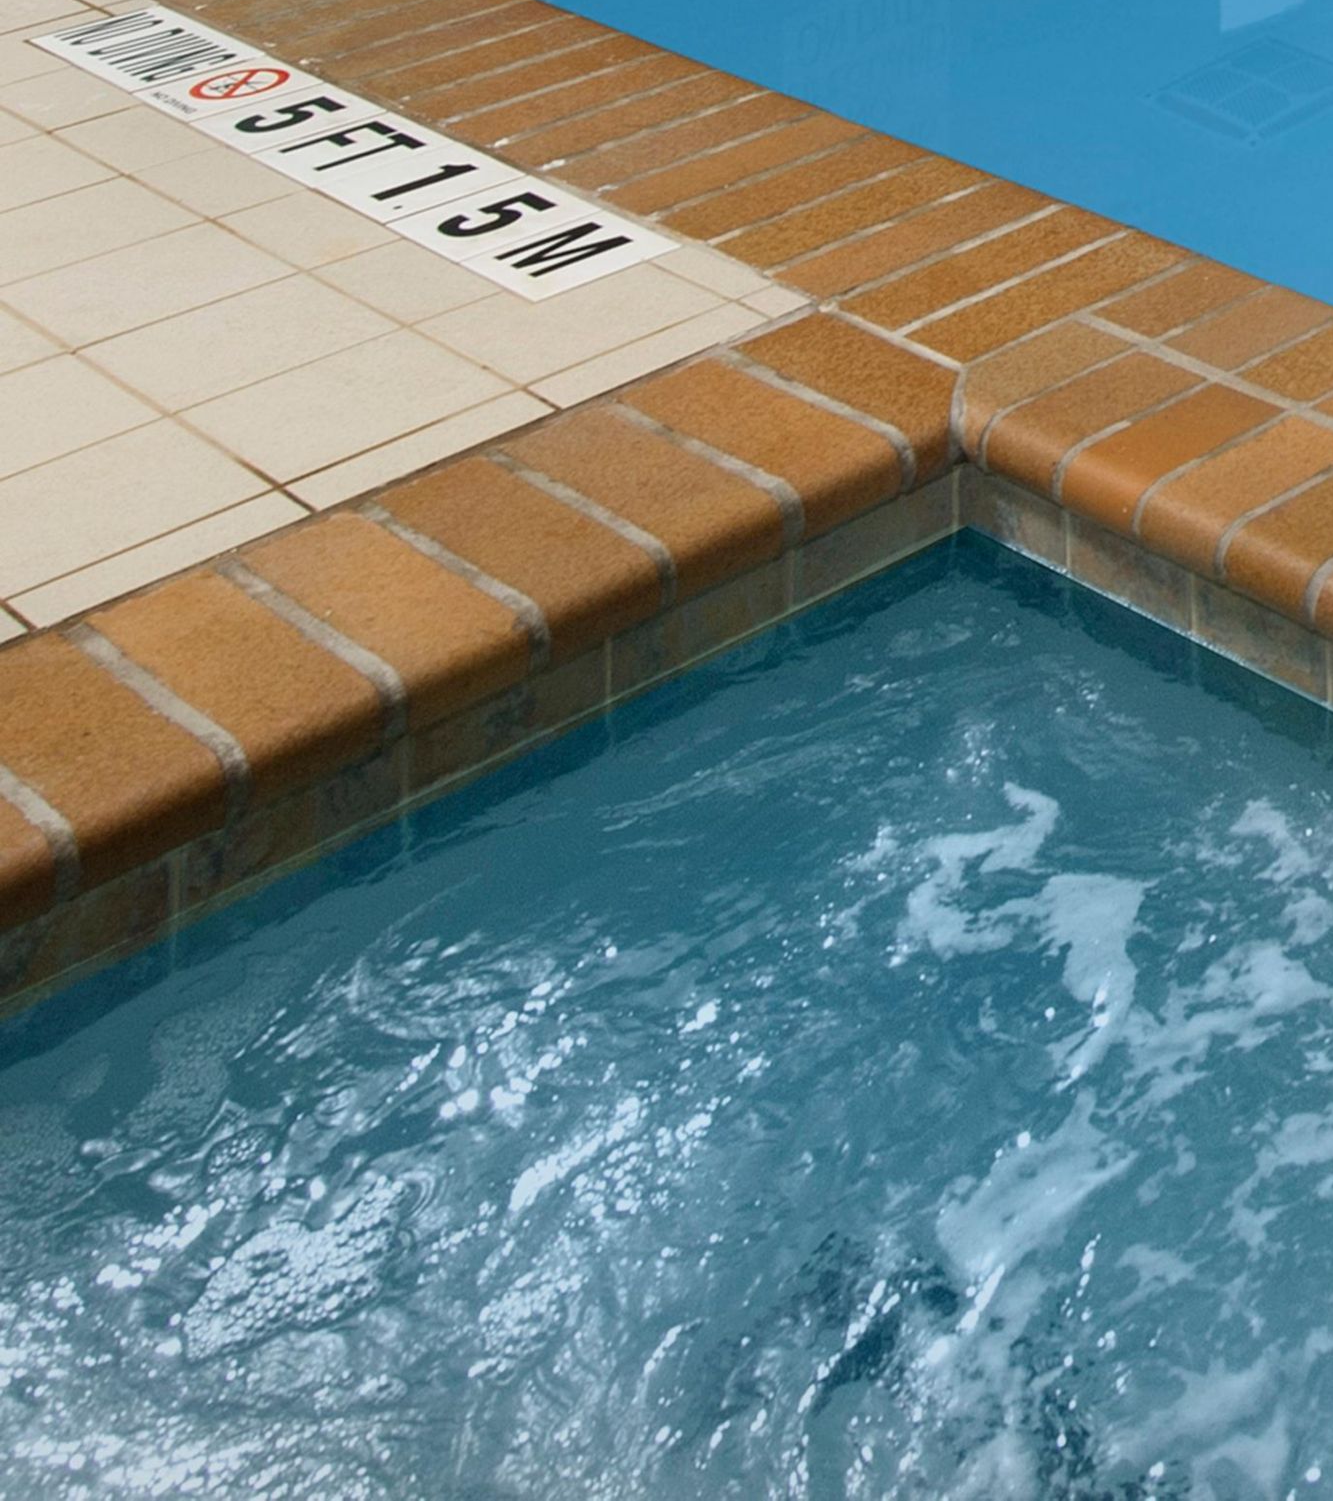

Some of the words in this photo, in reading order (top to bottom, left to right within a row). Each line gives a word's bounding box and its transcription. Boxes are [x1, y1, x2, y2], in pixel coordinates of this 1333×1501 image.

[54, 11, 164, 46] NO
[87, 27, 237, 83] DIVING
[234, 95, 347, 134] 5
[279, 120, 427, 172] FT
[494, 221, 633, 278] M
